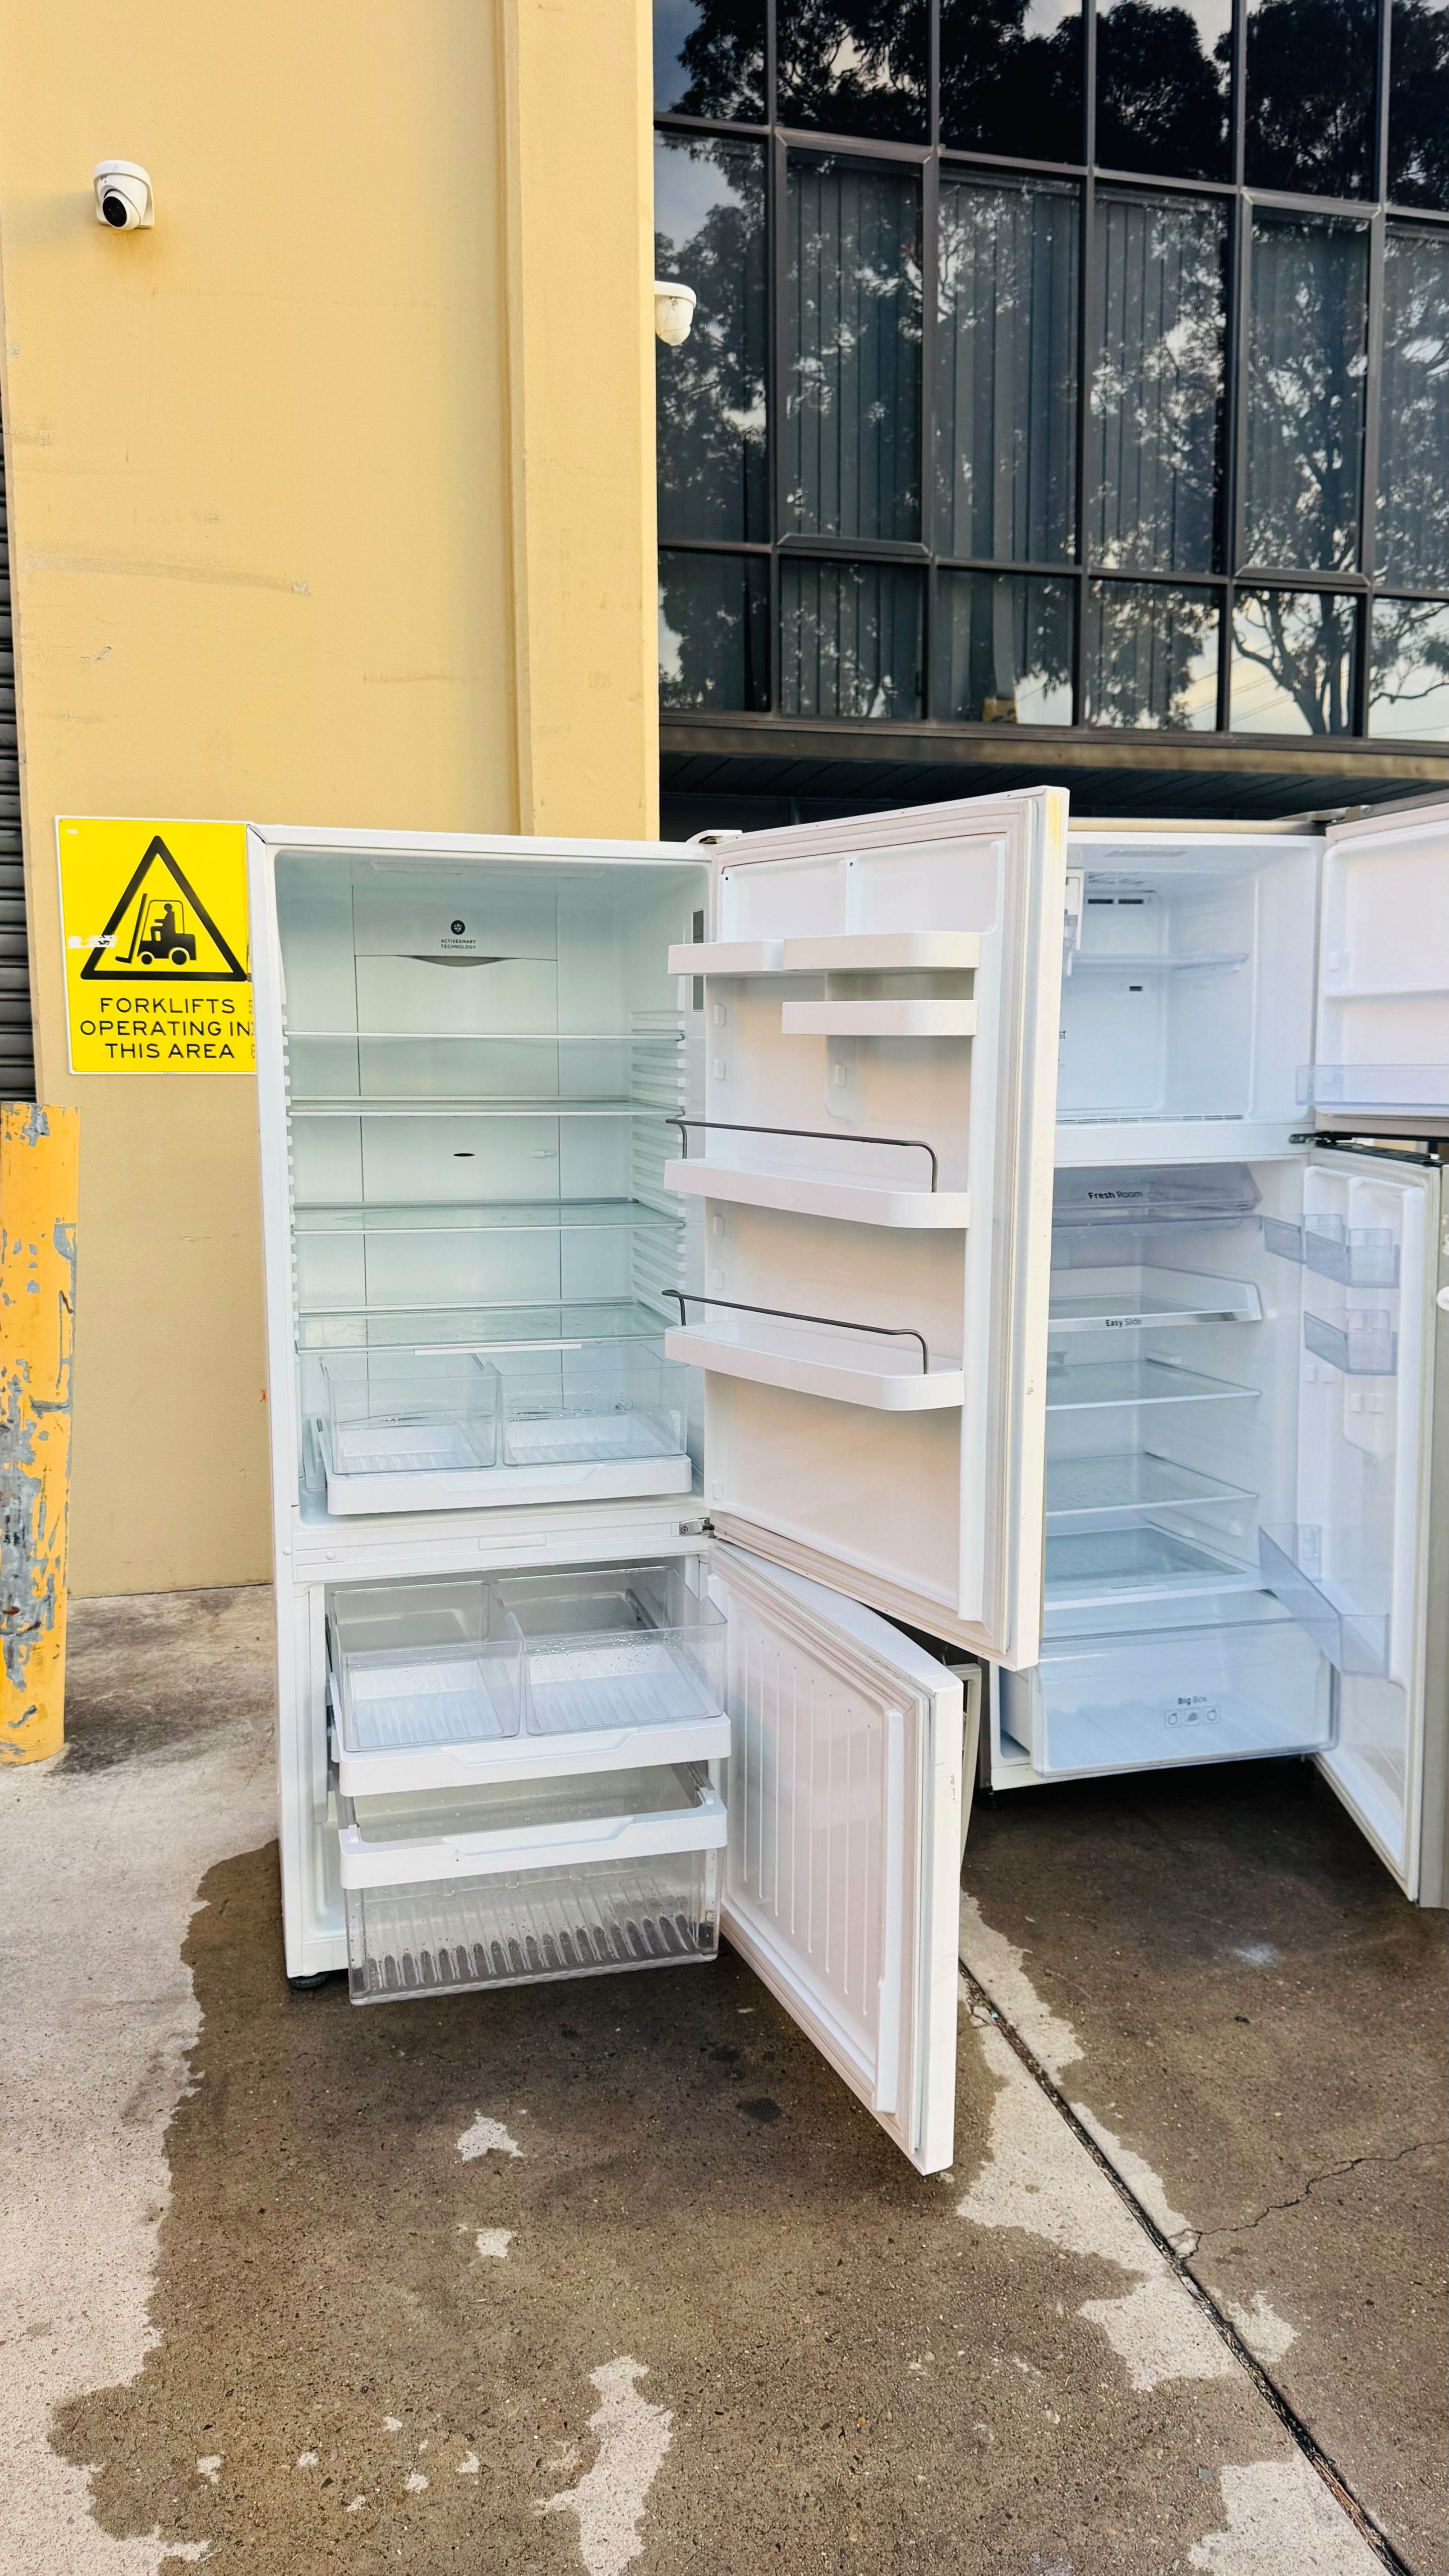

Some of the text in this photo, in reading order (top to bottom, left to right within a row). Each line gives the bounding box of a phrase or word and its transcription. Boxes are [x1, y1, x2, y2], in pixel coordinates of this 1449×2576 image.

[100, 998, 235, 1014] FORKLIFTS
[80, 1020, 250, 1036] OPERATING IN
[105, 1043, 235, 1059] THIS AREA
[1088, 1191, 1115, 1199] Fresh
[1105, 1319, 1123, 1328] Easy
[1178, 1696, 1207, 1706] Big Box
